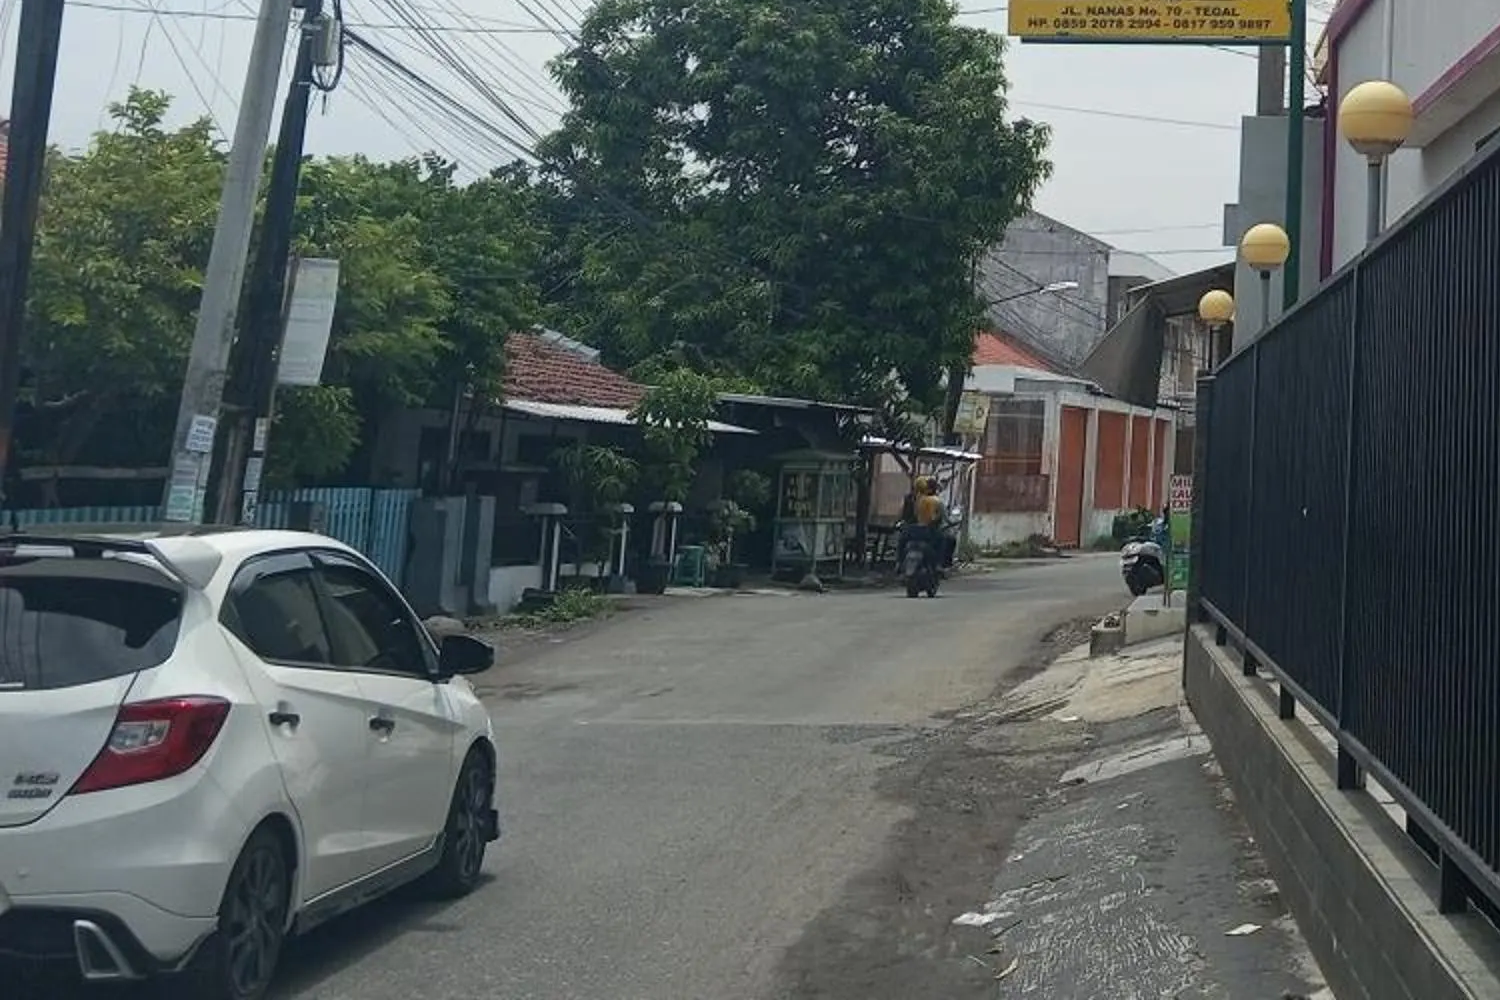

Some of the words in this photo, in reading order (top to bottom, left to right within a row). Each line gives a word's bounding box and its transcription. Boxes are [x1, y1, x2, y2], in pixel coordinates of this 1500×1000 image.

[1087, 6, 1135, 17] NANAS
[1166, 6, 1182, 17] 70
[1194, 6, 1241, 17] TEGAL
